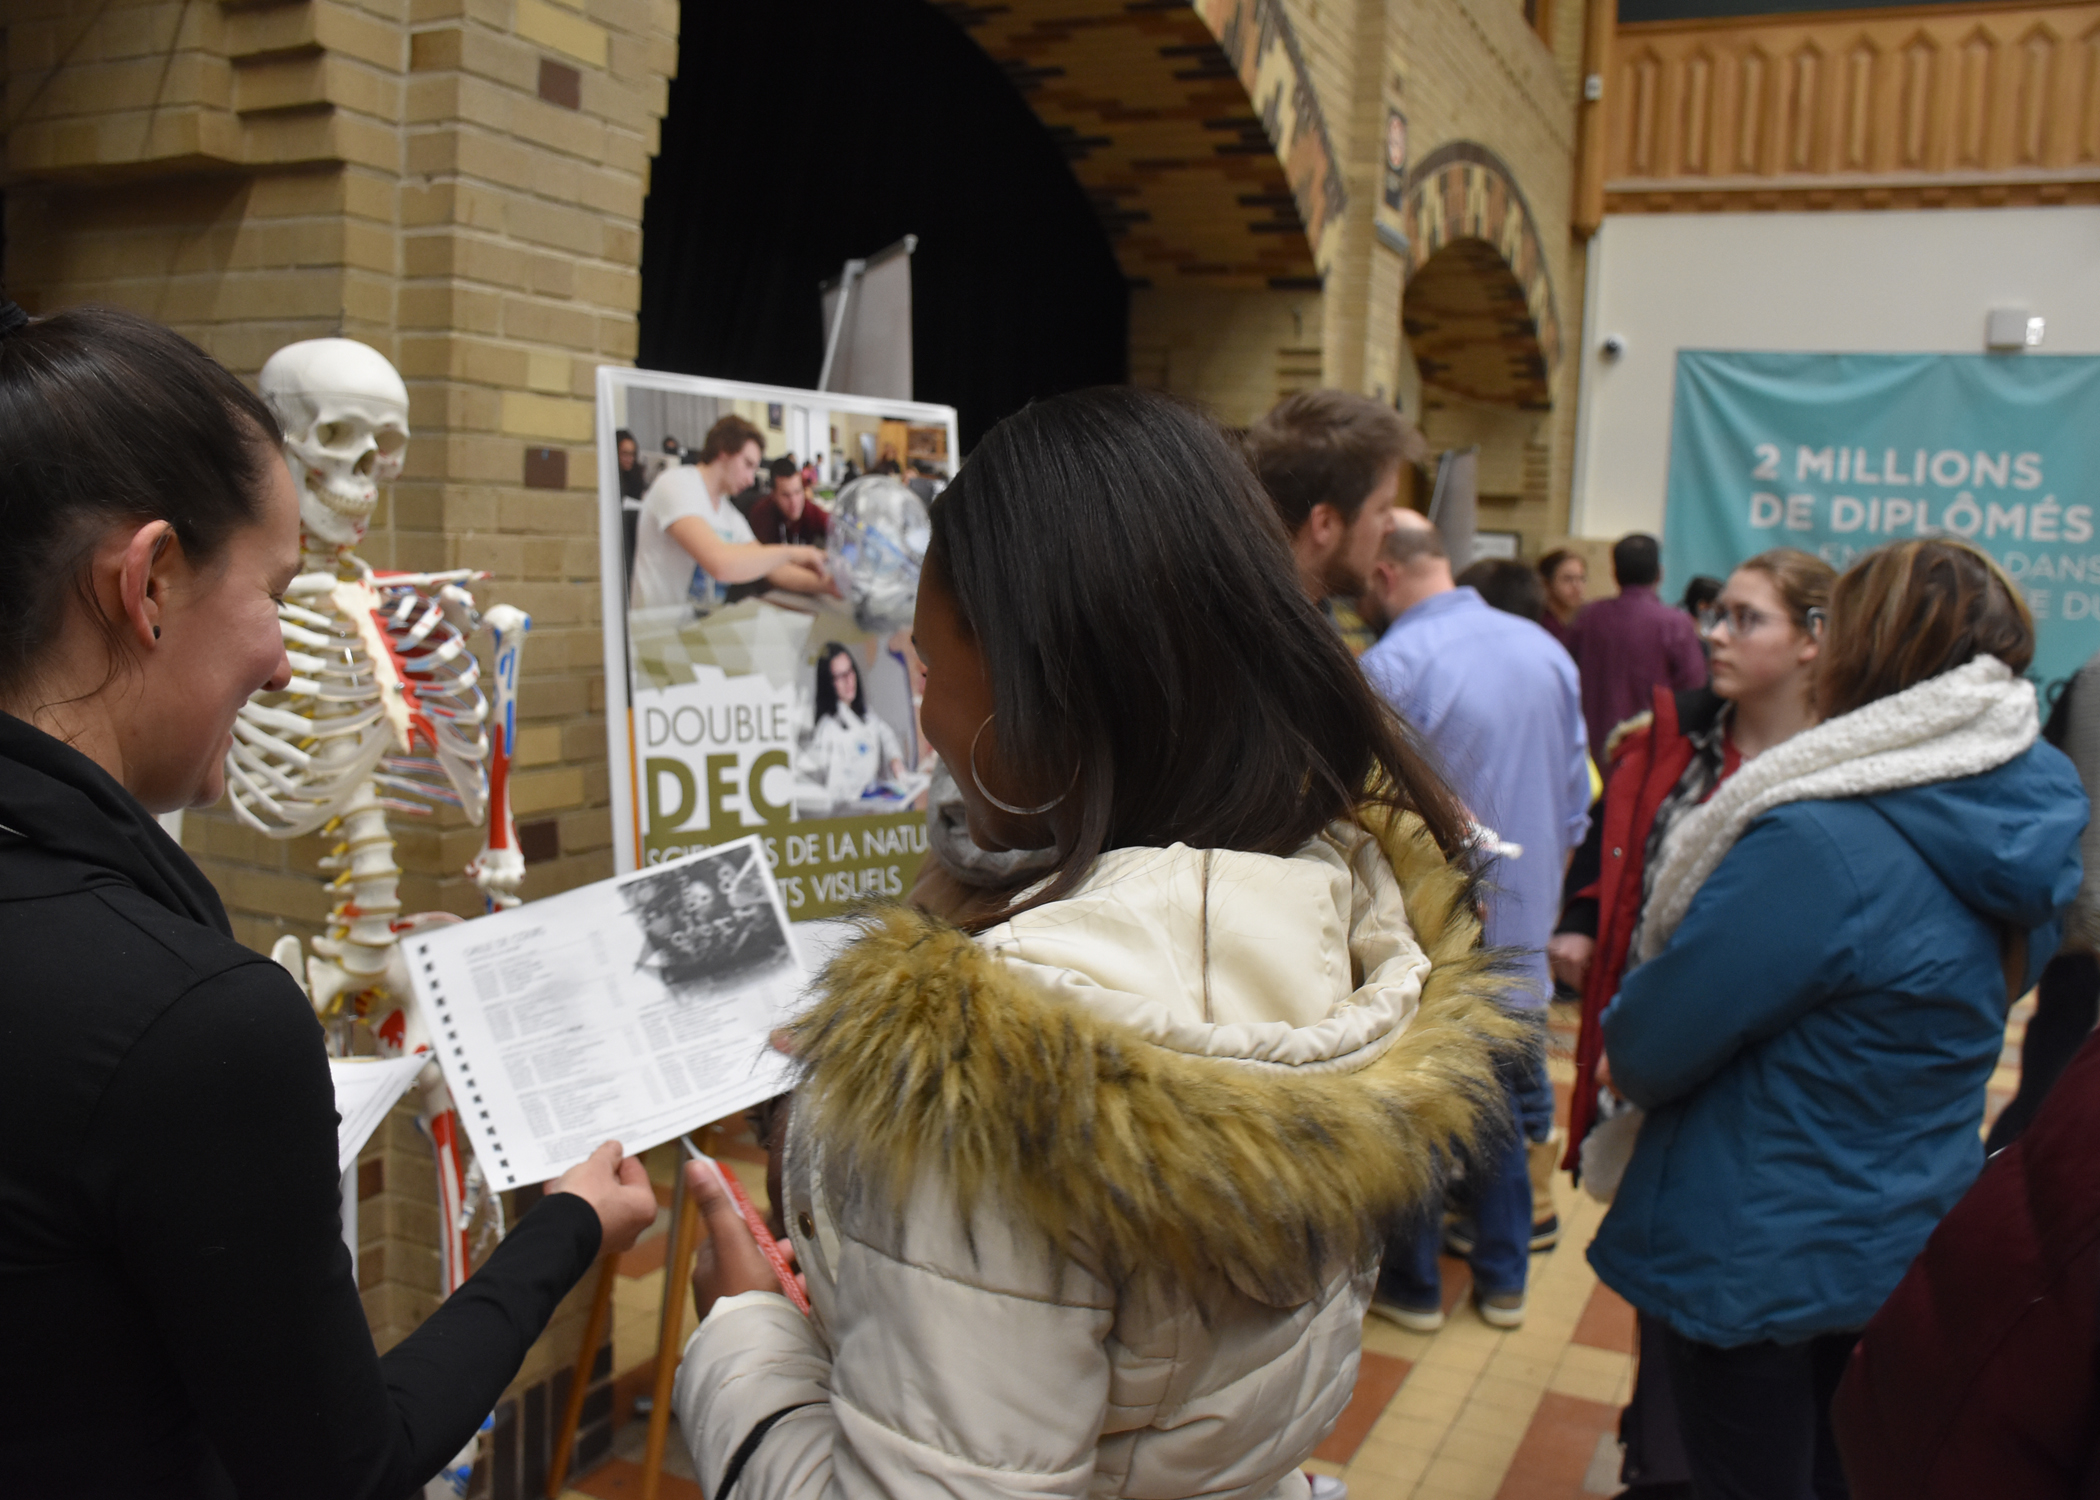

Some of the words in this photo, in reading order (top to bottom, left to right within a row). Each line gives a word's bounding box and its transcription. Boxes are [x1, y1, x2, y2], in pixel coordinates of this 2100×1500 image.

[1753, 443, 1781, 480] 2
[1797, 445, 2043, 490] MILLIONS
[1751, 493, 1815, 531] DE
[1831, 491, 2094, 543] DIPLÔMÉS
[646, 703, 788, 747] DOUBLE
[646, 750, 791, 833] DEC
[786, 835, 820, 866] DE
[827, 831, 859, 862] LA
[862, 824, 927, 858] NATU
[810, 865, 902, 902] VISUELS
